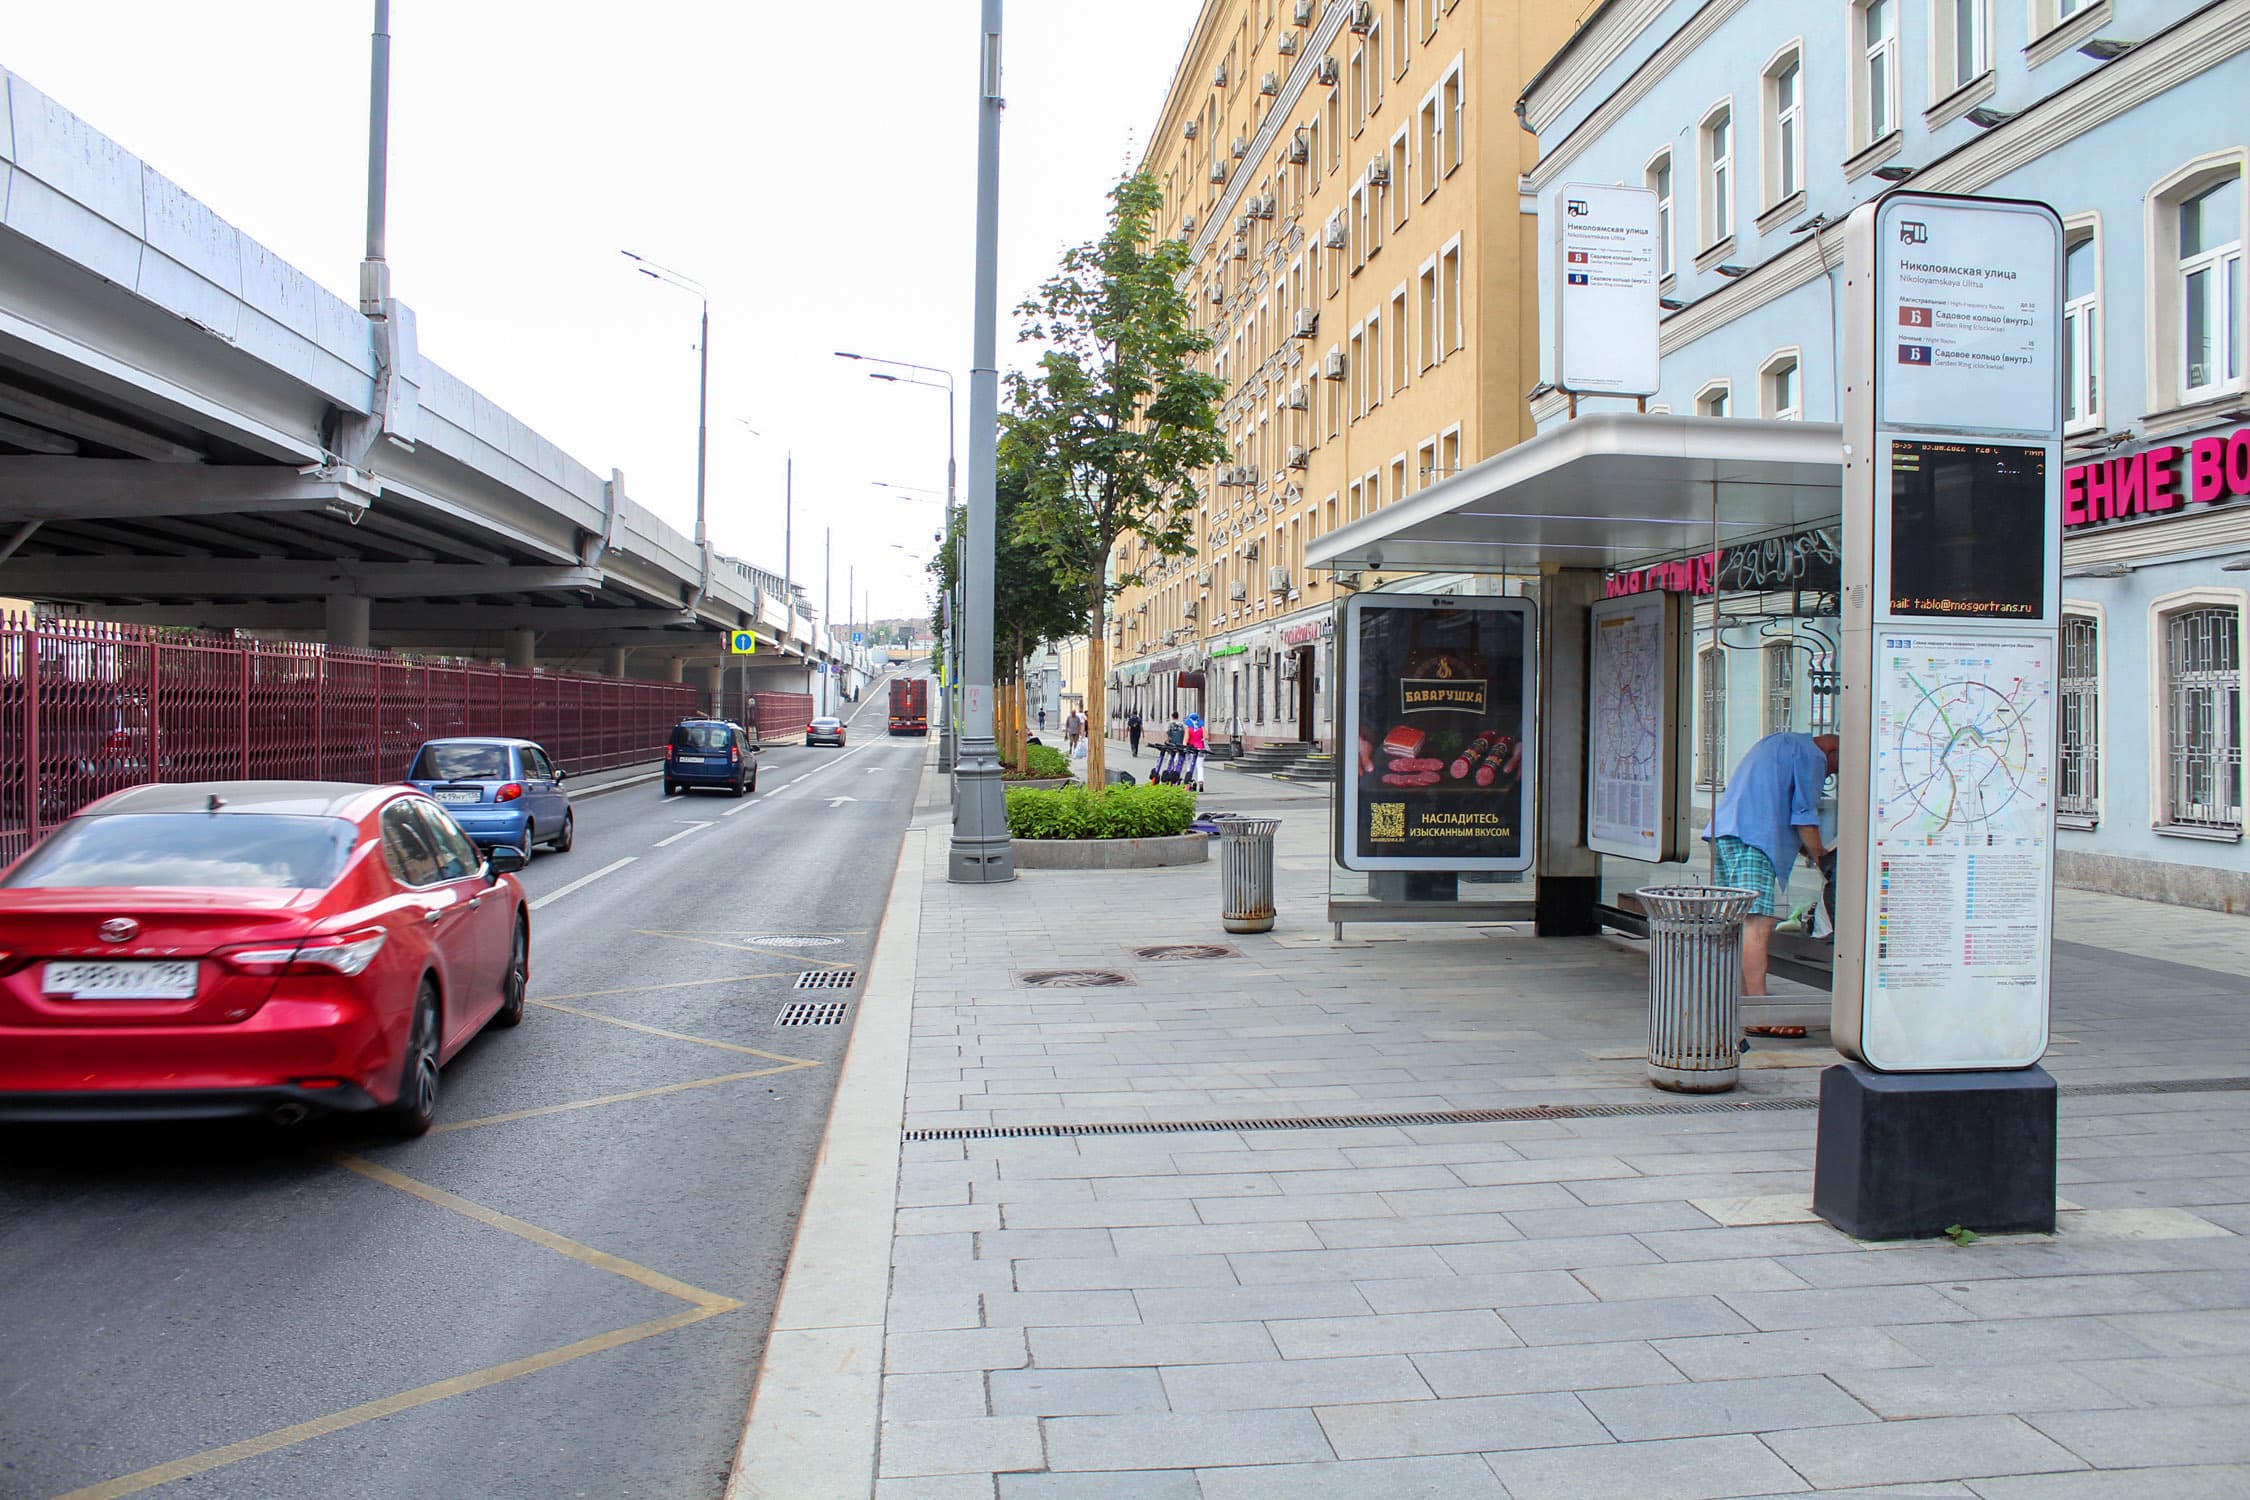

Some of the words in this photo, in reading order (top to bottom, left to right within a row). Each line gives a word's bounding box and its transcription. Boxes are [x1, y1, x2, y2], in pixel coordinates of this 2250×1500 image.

[1568, 223, 1624, 234] Николоямская
[1626, 228, 1649, 236] улица
[1900, 260, 1982, 276] Николоямская
[1984, 269, 2017, 280] улица
[1900, 274, 1961, 287] Nikoloyamskaya
[1962, 278, 1984, 289] Ulitsa
[1910, 310, 1922, 325] Б
[1936, 310, 1970, 322] Садовое
[1972, 315, 2002, 323] кольцо
[2003, 315, 2034, 327] (внутр.)
[1910, 347, 1921, 361] Б
[1935, 348, 1970, 359] Садовое
[1971, 352, 2001, 361] кольцо
[2002, 353, 2033, 364] (внутр.)
[1915, 598, 2032, 613] tablo@mosgortrans.ru
[1405, 690, 1483, 703] БАВАРУШКА
[1421, 813, 1499, 825] НАСЛАДИТЕСЬ
[1409, 828, 1473, 837] ИЗЫСКАННЫМ
[1475, 828, 1510, 837] ВКУСОМ
